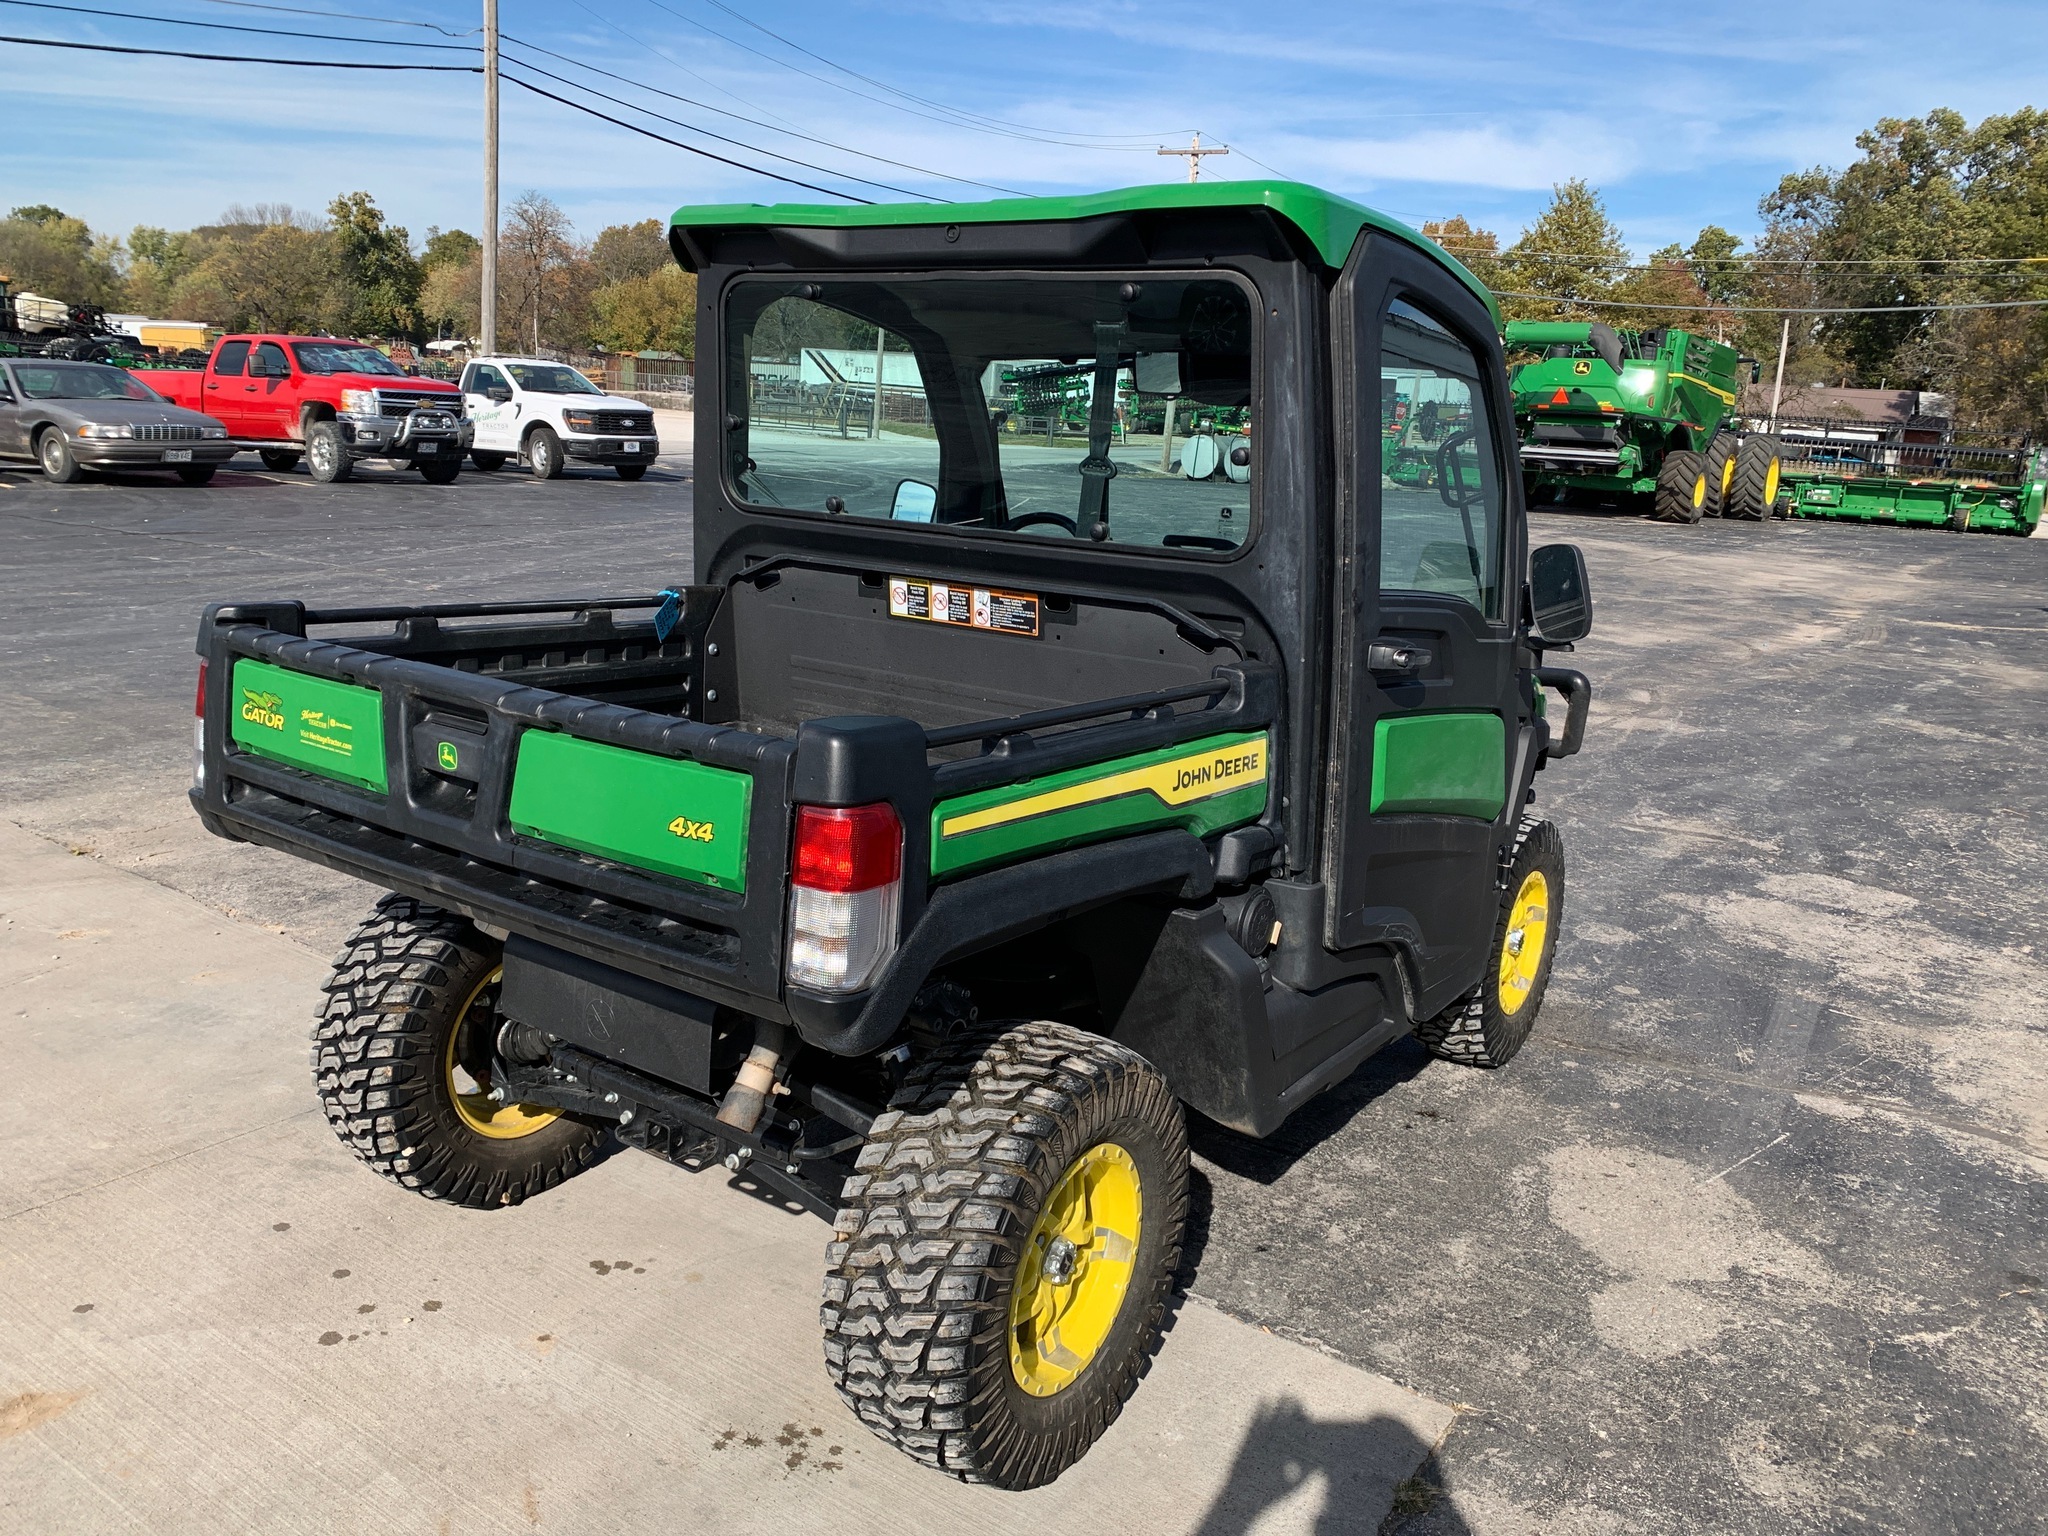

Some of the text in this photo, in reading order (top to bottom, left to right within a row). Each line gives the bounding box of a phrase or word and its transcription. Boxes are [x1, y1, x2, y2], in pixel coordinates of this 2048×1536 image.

[242, 702, 284, 731] GATOR
[1172, 752, 1259, 792] JOHN DEERE
